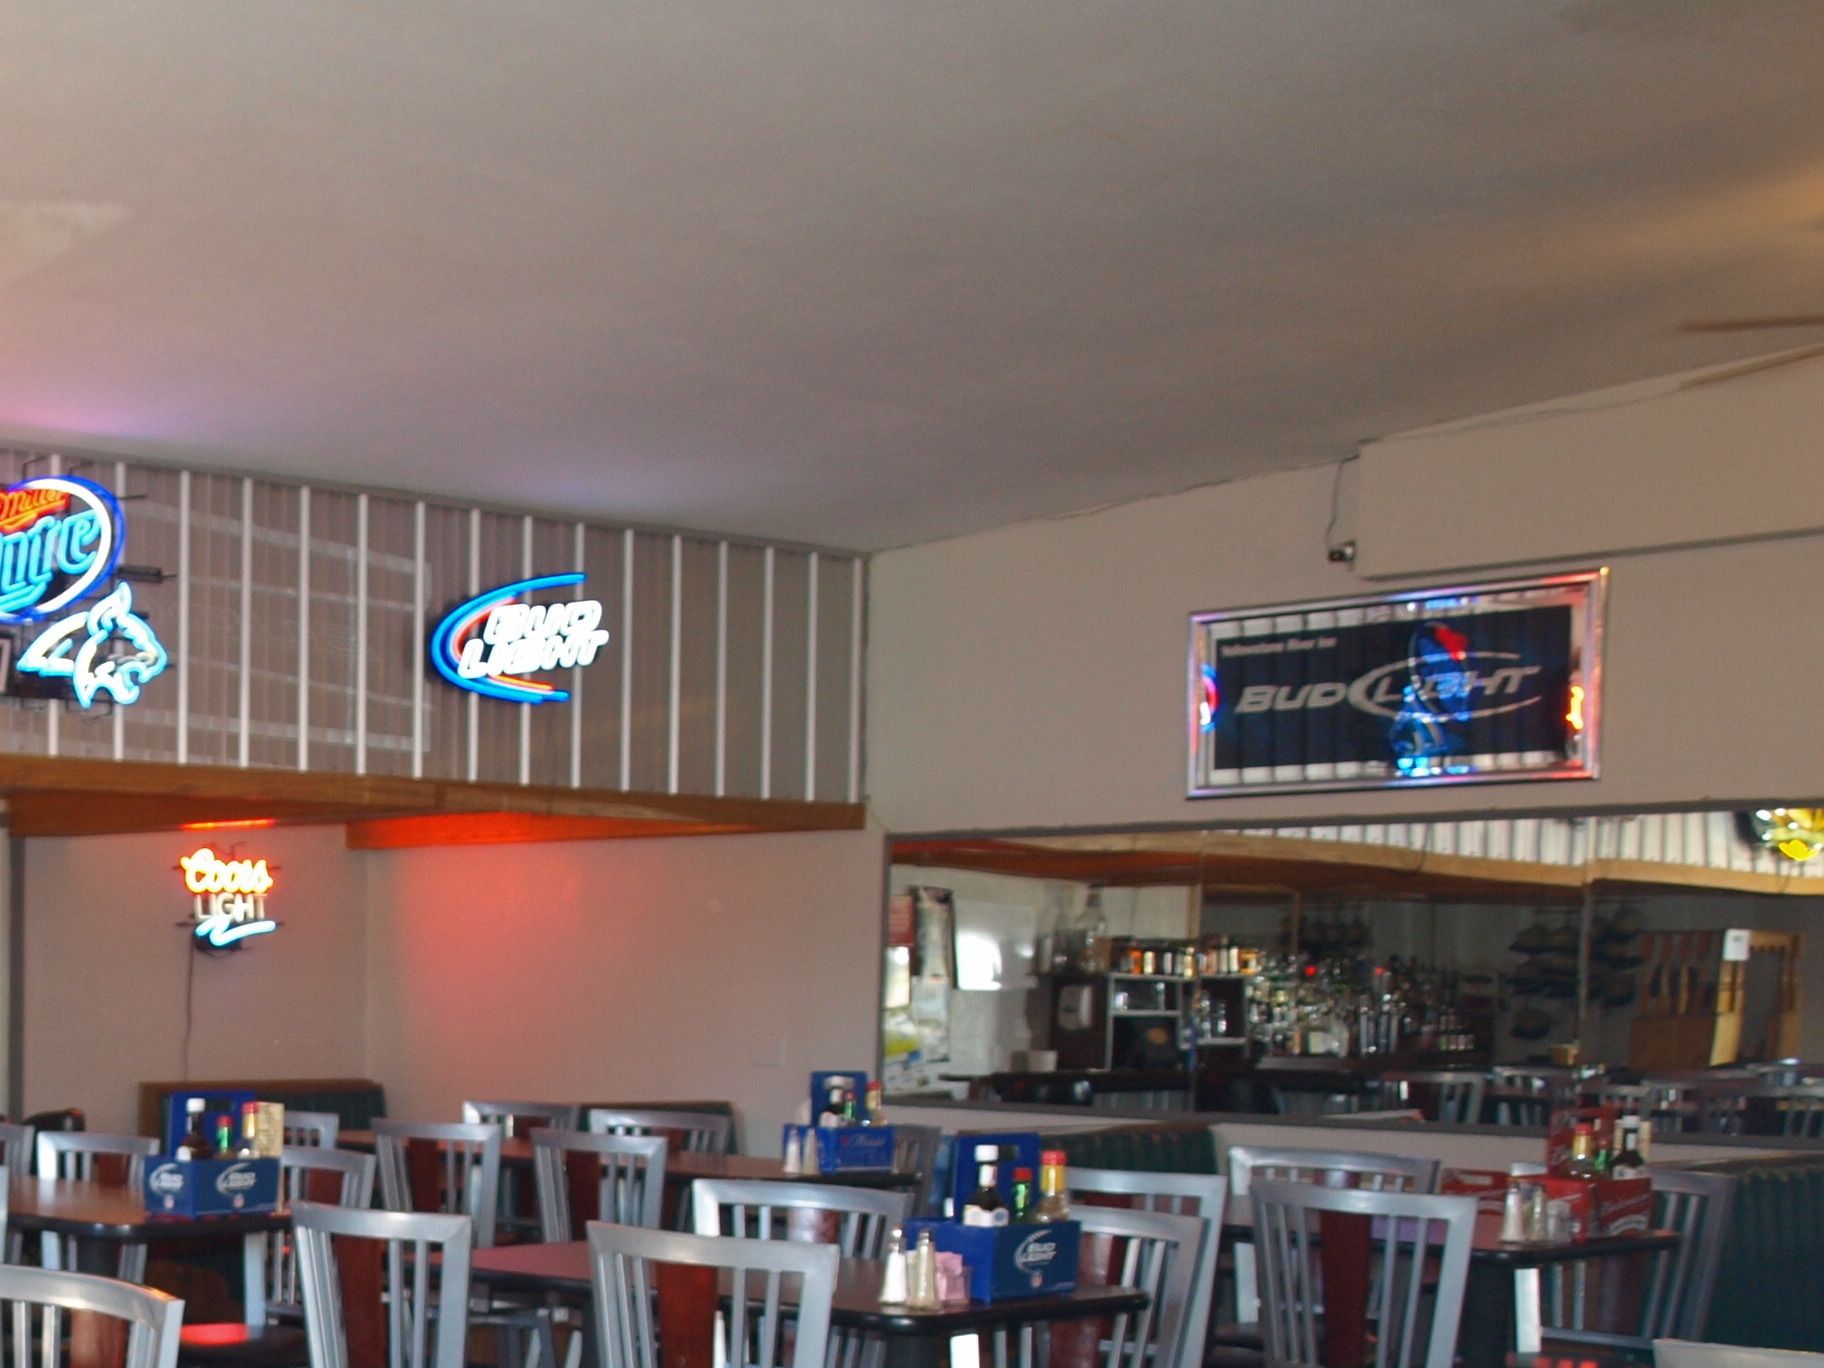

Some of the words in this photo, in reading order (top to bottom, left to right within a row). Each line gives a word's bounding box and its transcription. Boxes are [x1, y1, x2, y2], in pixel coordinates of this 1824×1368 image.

[1235, 682, 1348, 714] BUD
[180, 848, 274, 893] Coors
[193, 892, 269, 922] LIGHT
